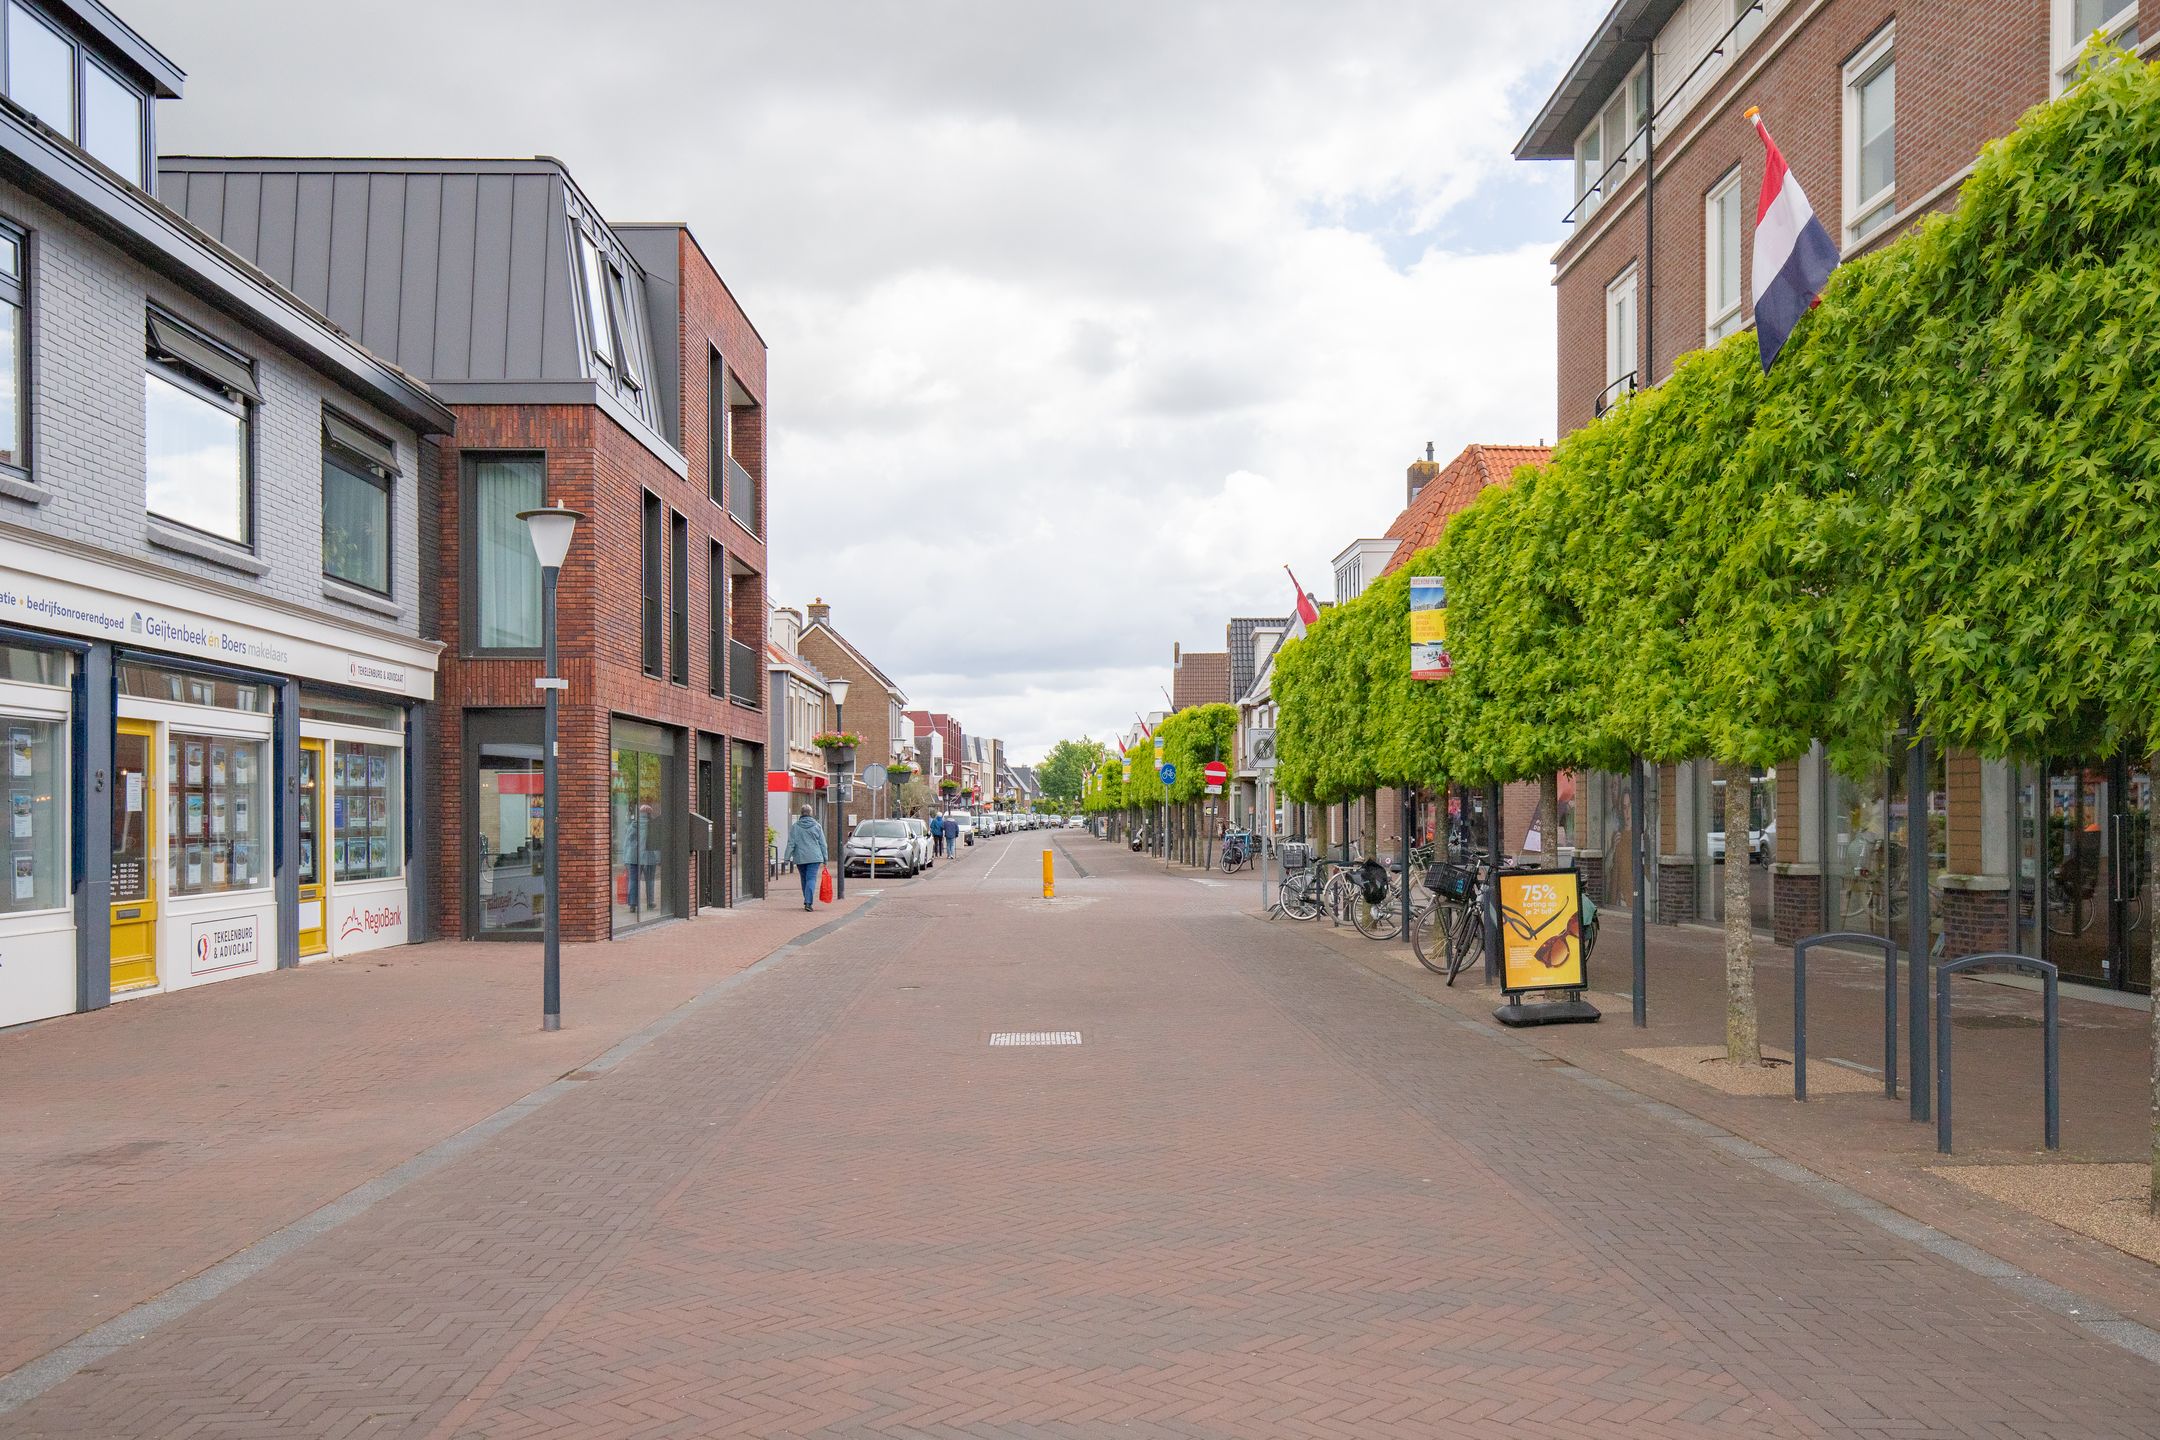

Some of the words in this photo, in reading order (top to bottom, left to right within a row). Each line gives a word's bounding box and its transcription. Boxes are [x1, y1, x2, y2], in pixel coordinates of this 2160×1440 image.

[27, 595, 125, 629] bedrijfsonroerendgoed
[146, 617, 207, 646] Geijtenbeek
[208, 630, 220, 649] én
[221, 633, 247, 655] Boers
[248, 642, 289, 664] makelaars
[1521, 884, 1557, 901] 75%
[1522, 901, 1547, 909] korting
[364, 904, 402, 934] RegioBank
[214, 927, 253, 943] TEKELENBURG
[213, 947, 218, 959] &
[219, 941, 253, 958] ADVOCAAT
